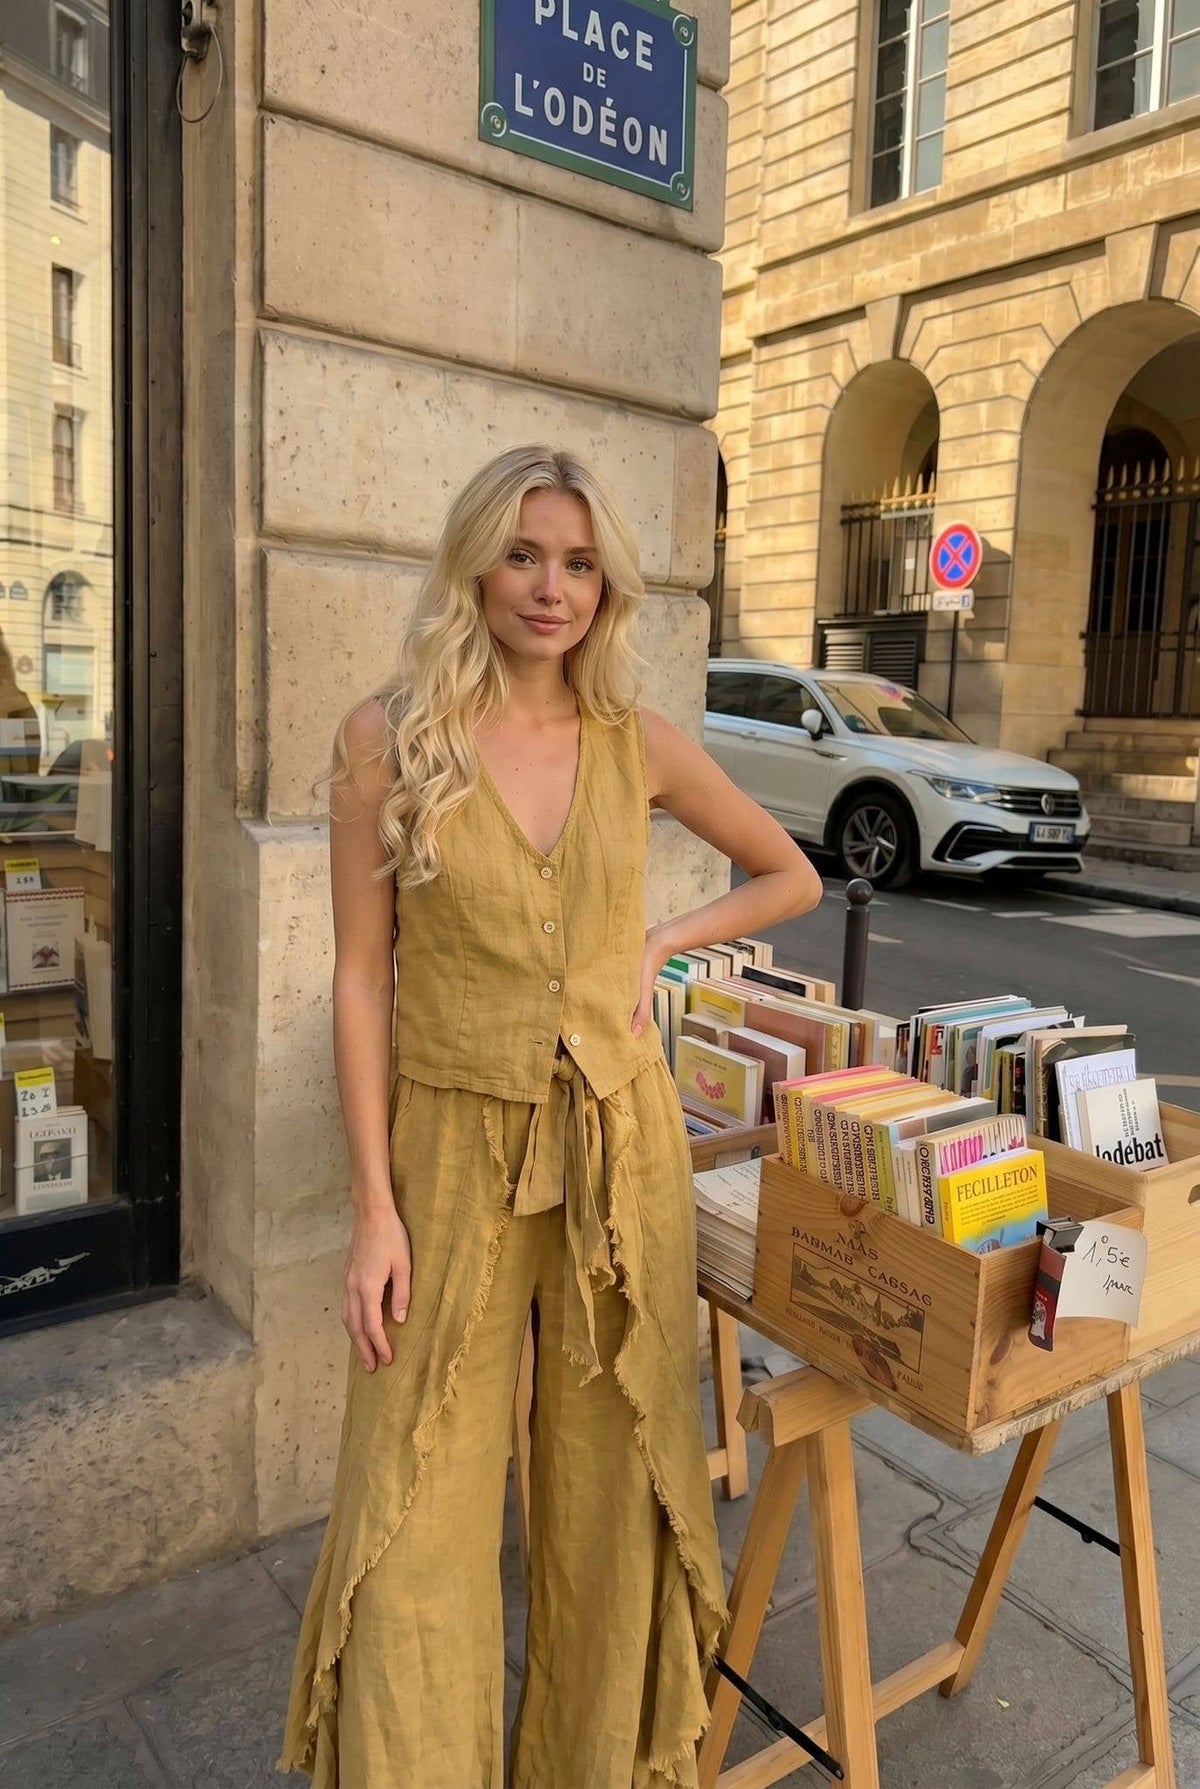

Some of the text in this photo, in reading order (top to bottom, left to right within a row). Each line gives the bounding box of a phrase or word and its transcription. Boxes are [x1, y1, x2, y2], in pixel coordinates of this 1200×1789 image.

[534, 0, 654, 72] PLACE
[583, 62, 607, 88] DE
[514, 72, 668, 166] L'ODÉON
[956, 1164, 1038, 1203] FECILLETON
